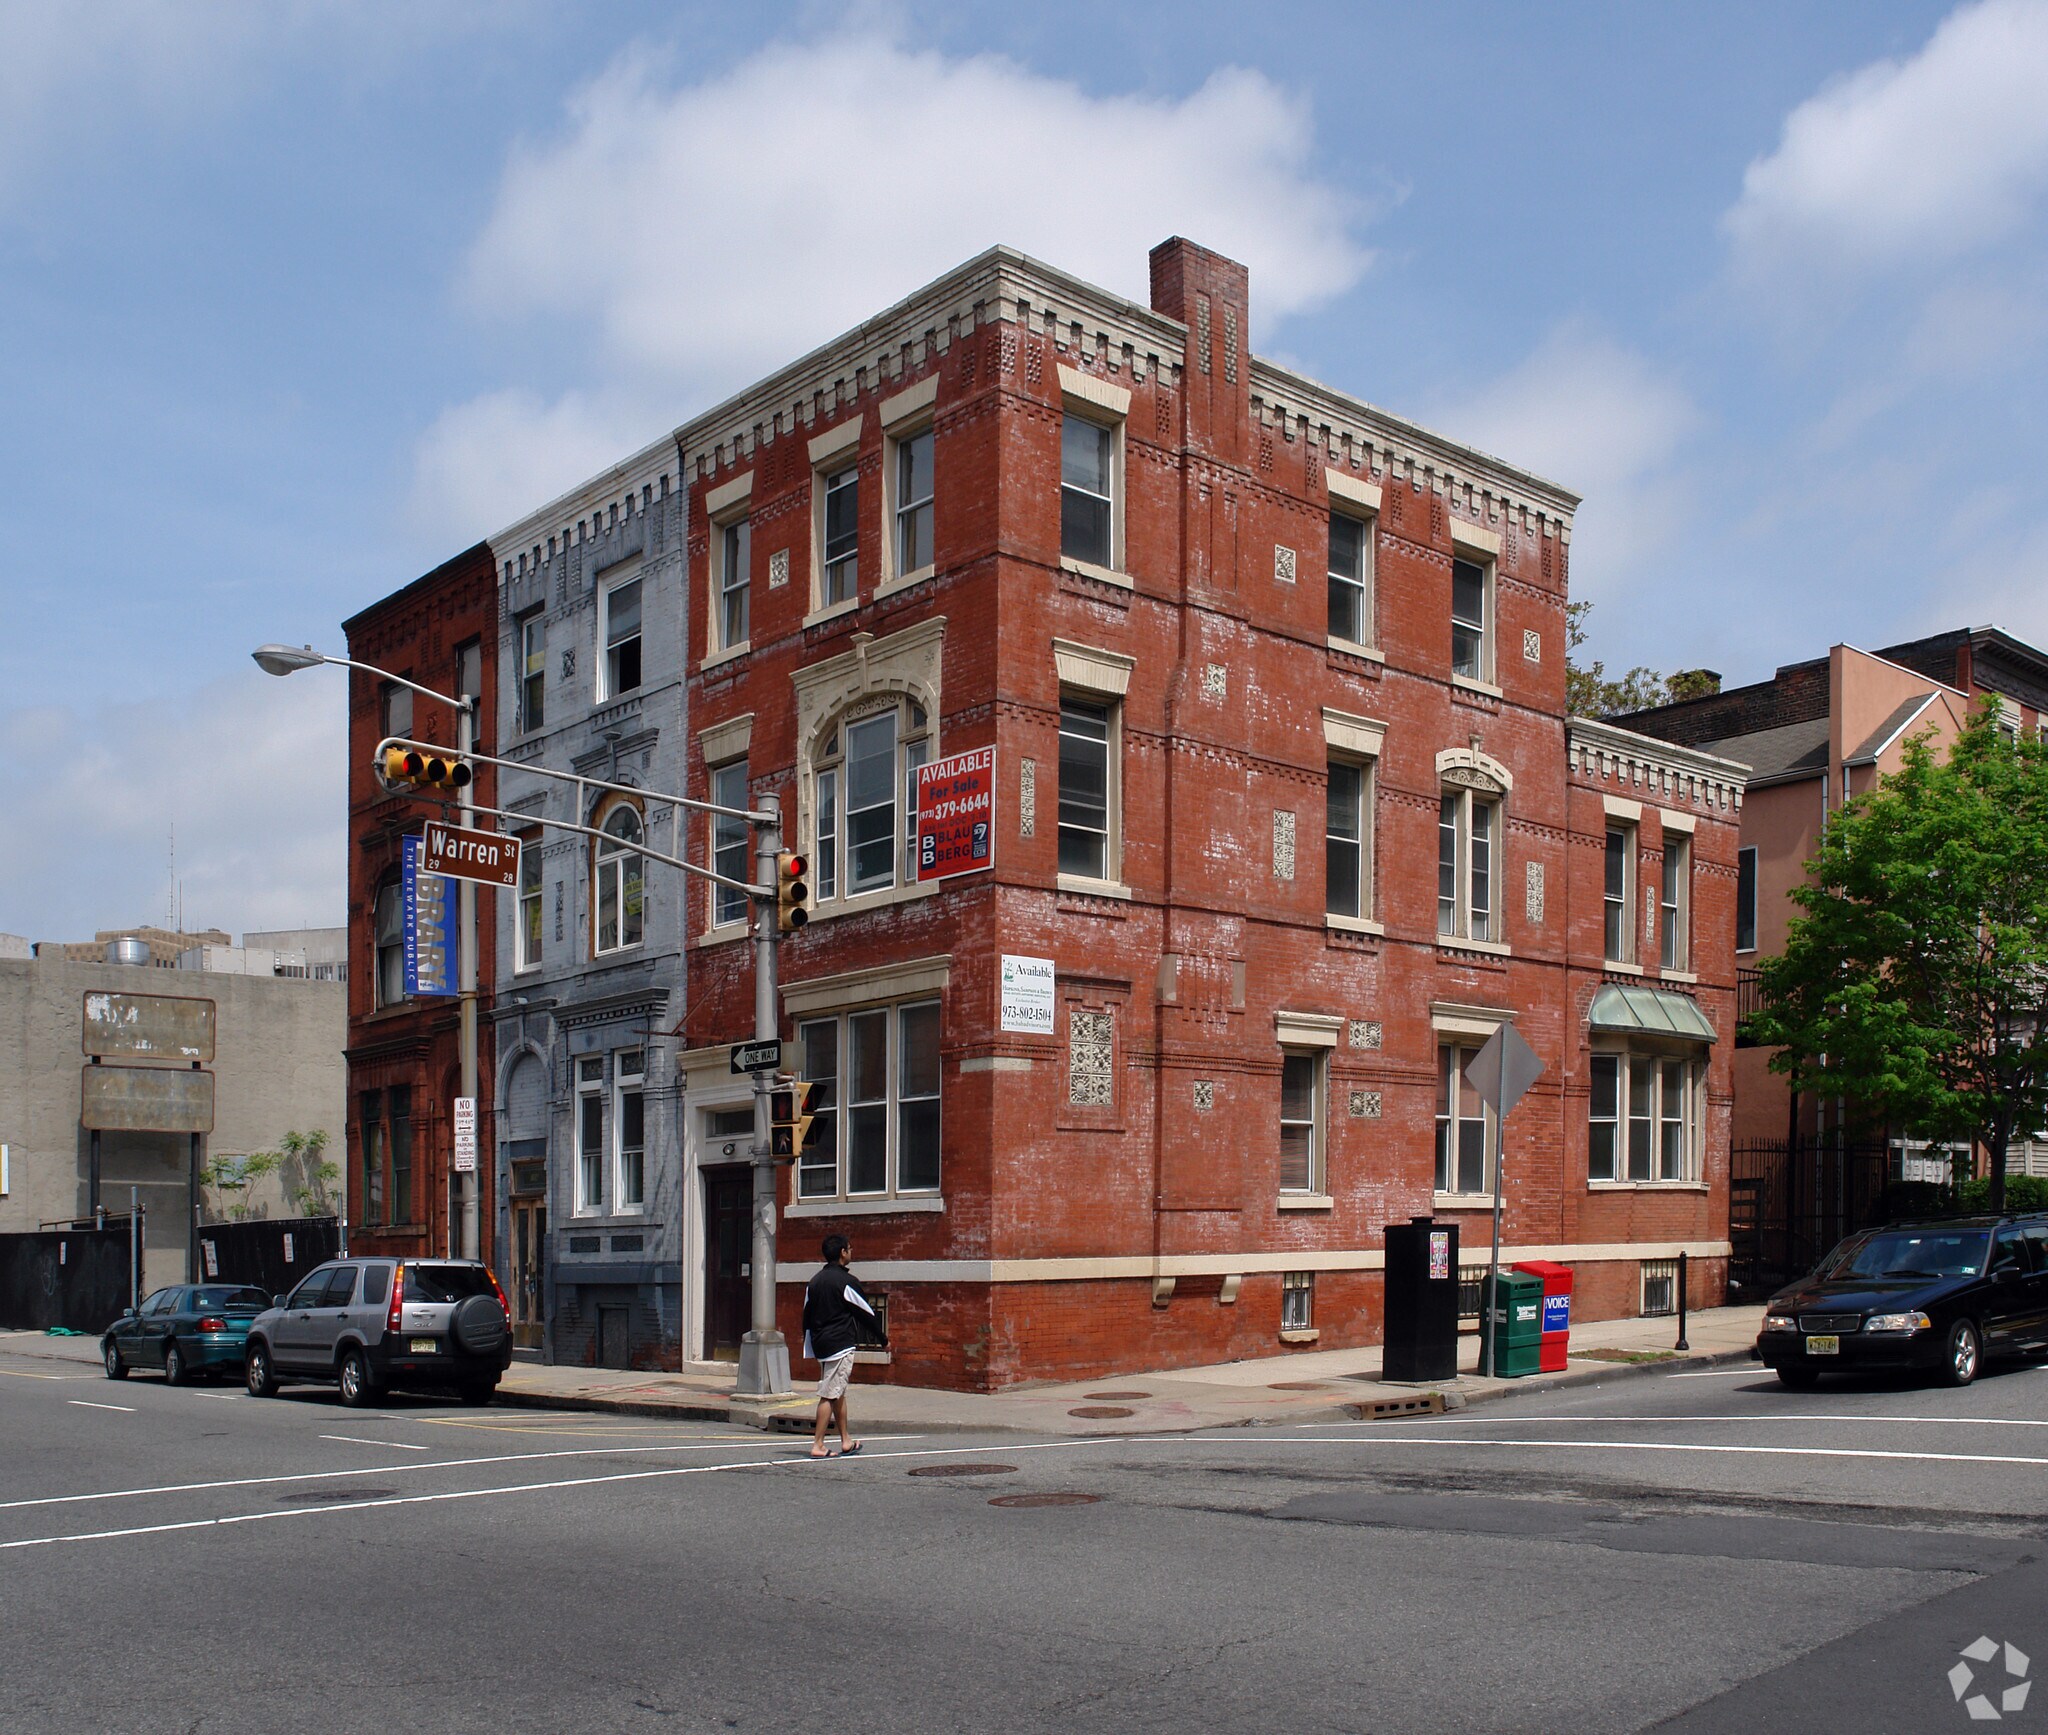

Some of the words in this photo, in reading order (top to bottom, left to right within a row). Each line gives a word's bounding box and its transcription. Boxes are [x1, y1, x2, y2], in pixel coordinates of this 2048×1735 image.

[922, 751, 990, 784] AVAILABLE
[930, 786, 949, 801] For
[953, 776, 979, 795] Sale
[920, 809, 935, 821] (973)
[935, 792, 989, 820] 379-6644
[922, 835, 935, 850] B
[938, 826, 970, 844] BLAU
[431, 829, 499, 866] Warren
[504, 844, 515, 858] St
[938, 844, 971, 862] BERG
[406, 847, 414, 870] THE
[428, 858, 440, 870] 29
[922, 851, 935, 865] B
[503, 872, 514, 883] 28
[406, 877, 414, 928] NEWARK
[416, 847, 446, 989] BRARY
[406, 936, 416, 980] PUBLIC
[1016, 964, 1052, 978] Available
[1003, 1005, 1052, 1021] 973-802-1504
[745, 1051, 760, 1064] ONE
[760, 1048, 776, 1062] WAY
[460, 1100, 470, 1109] NO
[1547, 1297, 1568, 1308] VOICE
